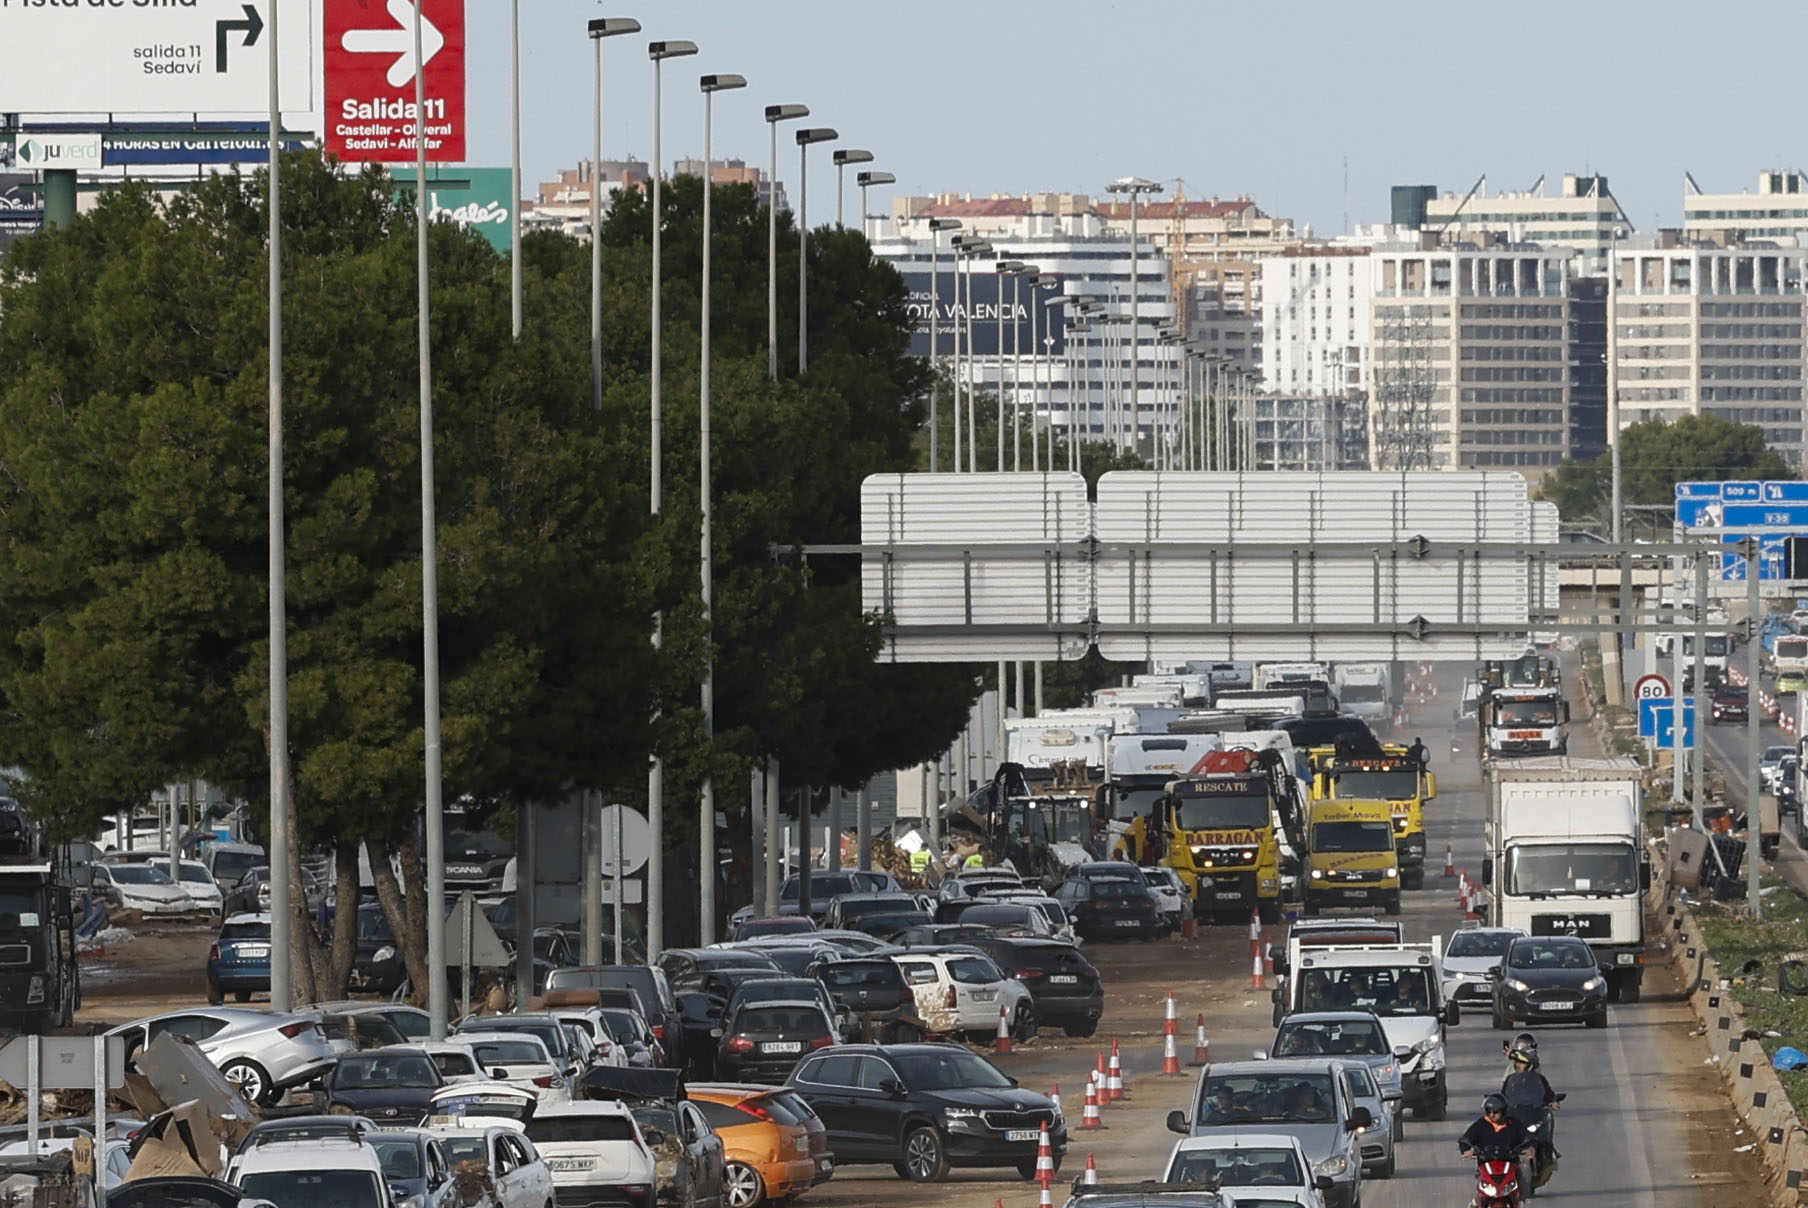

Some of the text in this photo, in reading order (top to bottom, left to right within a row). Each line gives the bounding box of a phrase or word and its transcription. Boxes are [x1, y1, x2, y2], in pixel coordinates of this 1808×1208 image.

[133, 45, 202, 58] salida 11
[143, 61, 202, 74] Sedaví
[342, 97, 446, 120] Salida 11
[336, 123, 392, 136] Castellar
[1641, 686, 1663, 698] 80
[1195, 782, 1248, 793] RESCATE
[1185, 831, 1265, 846] BARRAGAN
[445, 866, 483, 874] SCANIA
[1552, 920, 1591, 929] MAN
